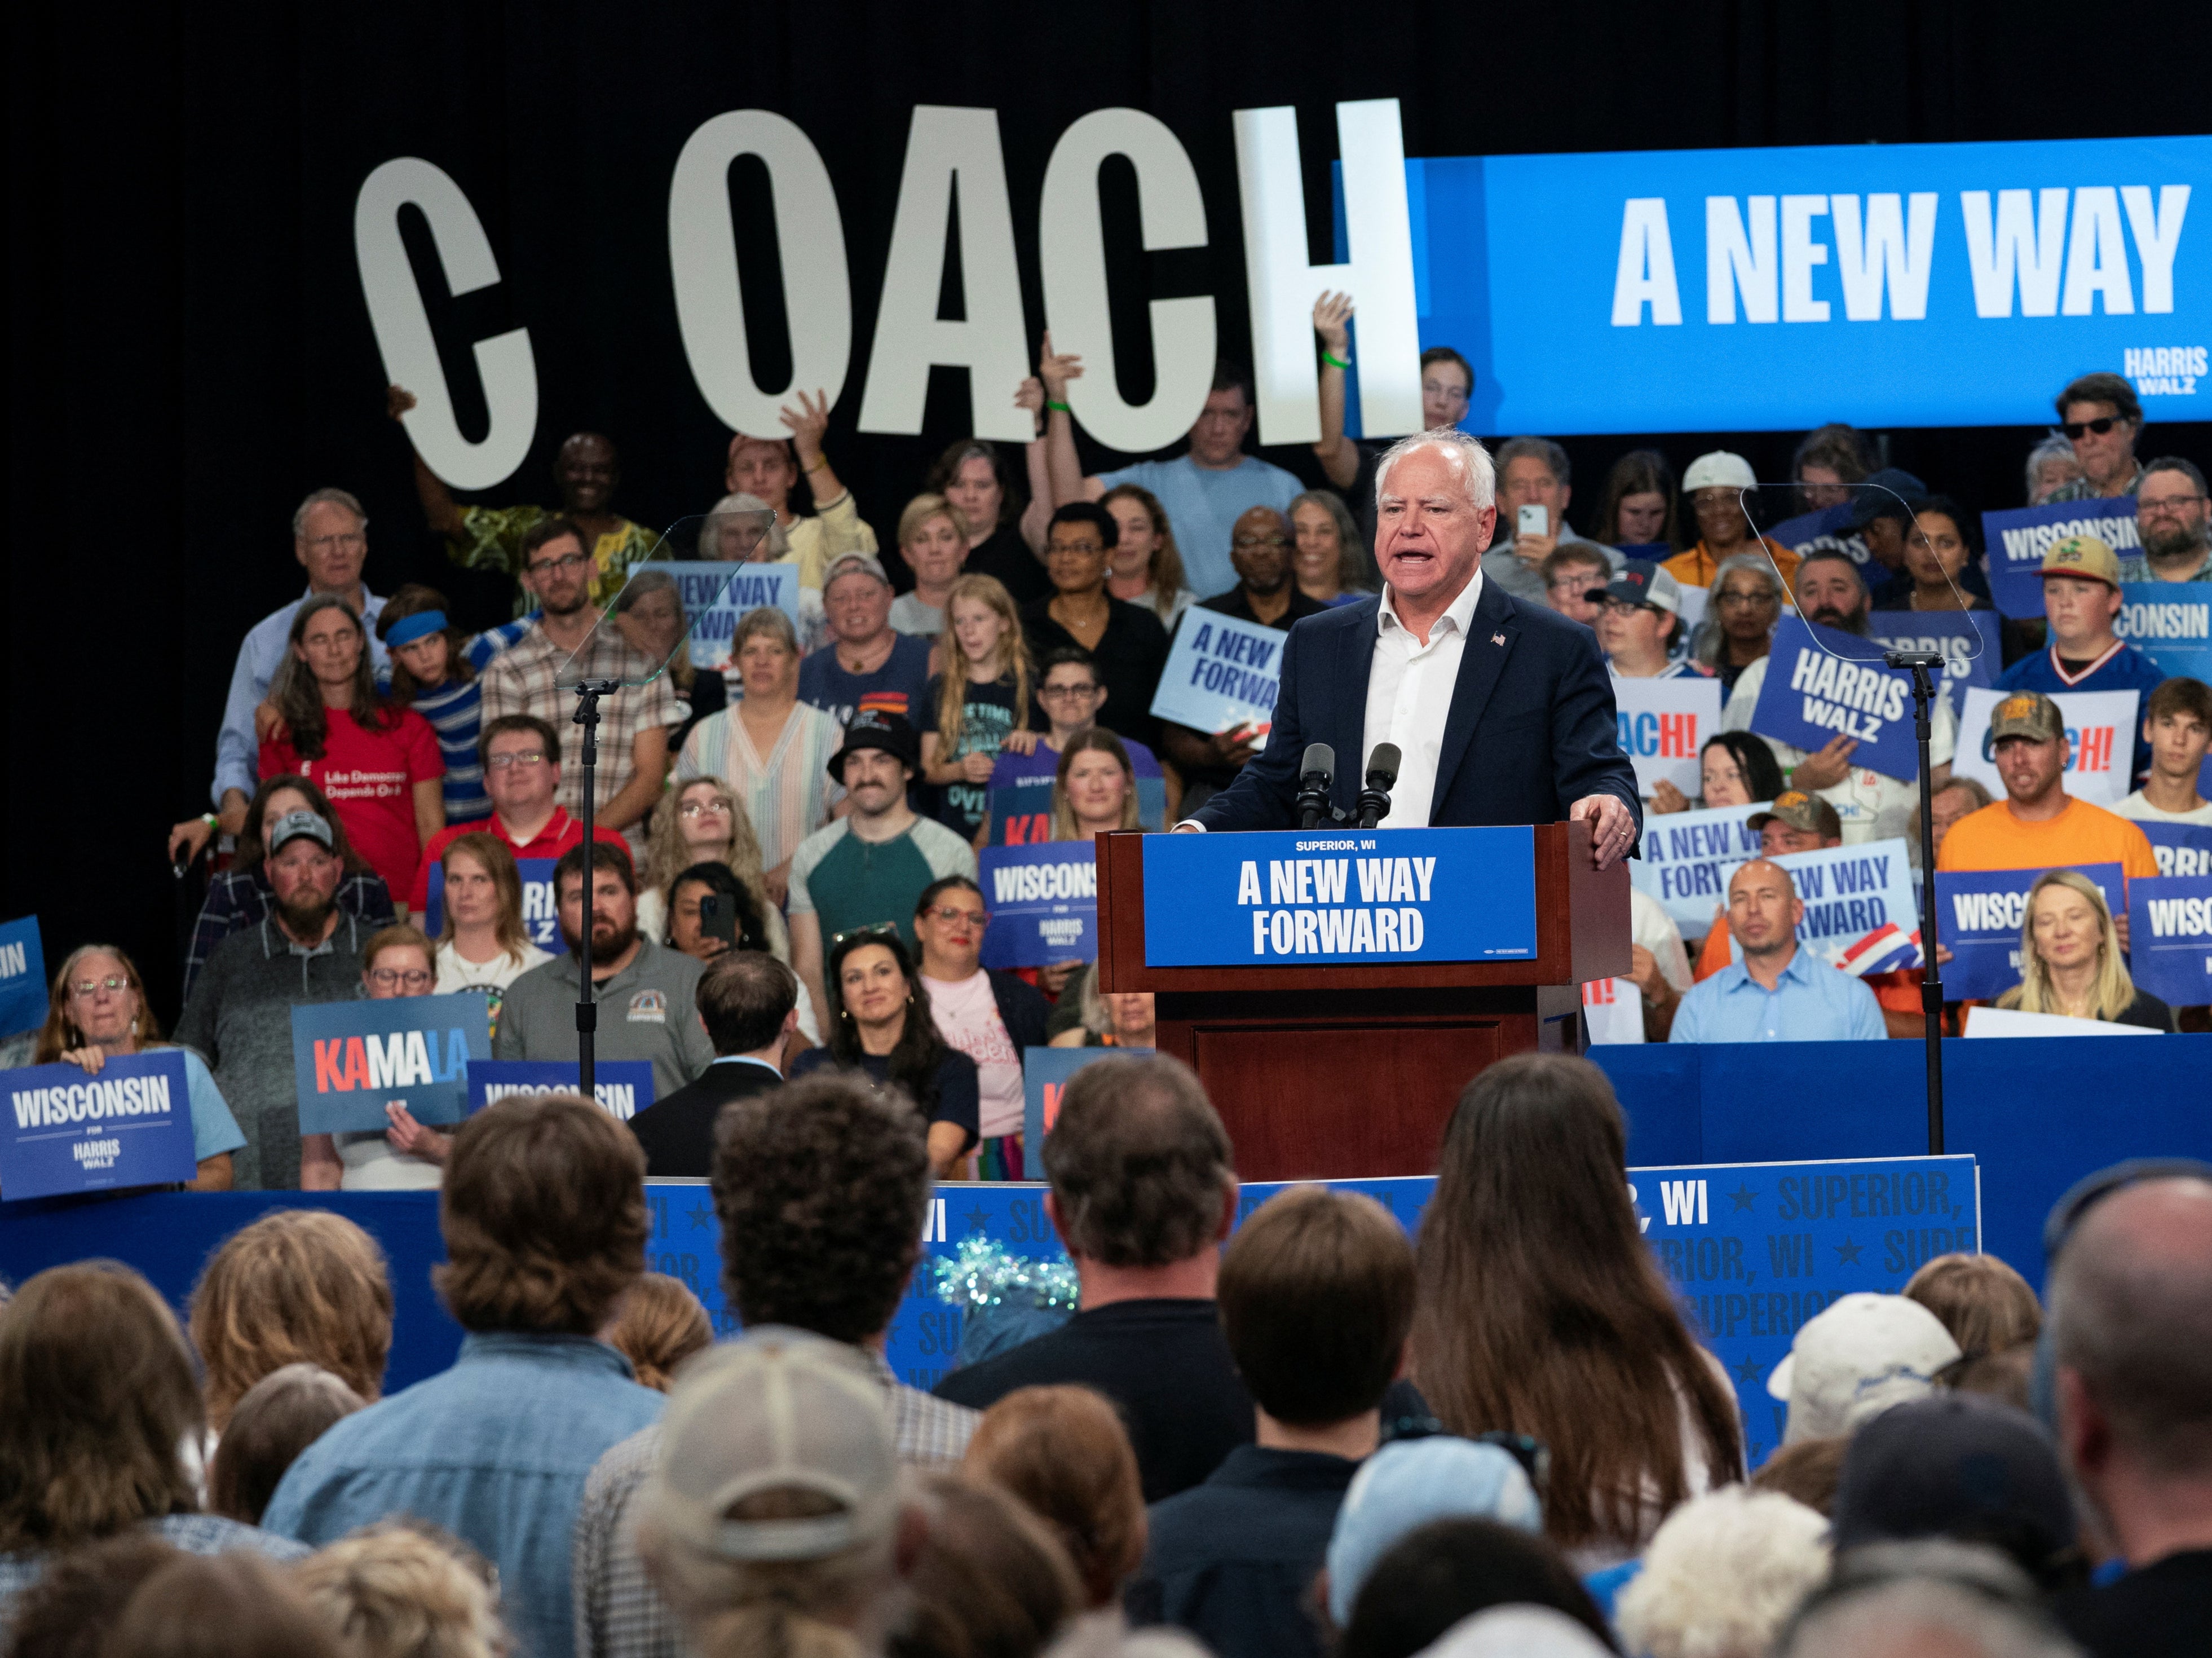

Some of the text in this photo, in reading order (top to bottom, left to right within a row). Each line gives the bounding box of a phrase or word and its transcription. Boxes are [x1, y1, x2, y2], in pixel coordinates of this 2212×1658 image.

[1610, 184, 2192, 327] A NEW WAY
[2123, 345, 2209, 379] HARRIS
[2137, 376, 2196, 395] WALZ
[727, 574, 783, 606] WAY
[2111, 602, 2210, 639] CONSIN
[1191, 623, 1277, 670] A NEW
[1190, 656, 1278, 712] FORWA
[1790, 646, 1910, 723] HARRIS
[1617, 711, 1697, 759] ACH!
[1802, 695, 1883, 744] WALZ
[1296, 840, 1376, 852] SUPERIOR, WI
[1648, 830, 1664, 863] A
[1670, 822, 1729, 861] NEW
[1237, 857, 1437, 905] A NEW WAY
[1830, 854, 1889, 896] WAY
[1252, 907, 1424, 955] FORWARD
[314, 1027, 471, 1094] KAMALA
[11, 1074, 171, 1129] WISCONSIN
[73, 1138, 121, 1162] HARRIS
[82, 1156, 115, 1171] WALZ
[1660, 1179, 1708, 1225] WI
[1778, 1170, 1964, 1222] SUPERIOR,
[1767, 1233, 1814, 1278] WI
